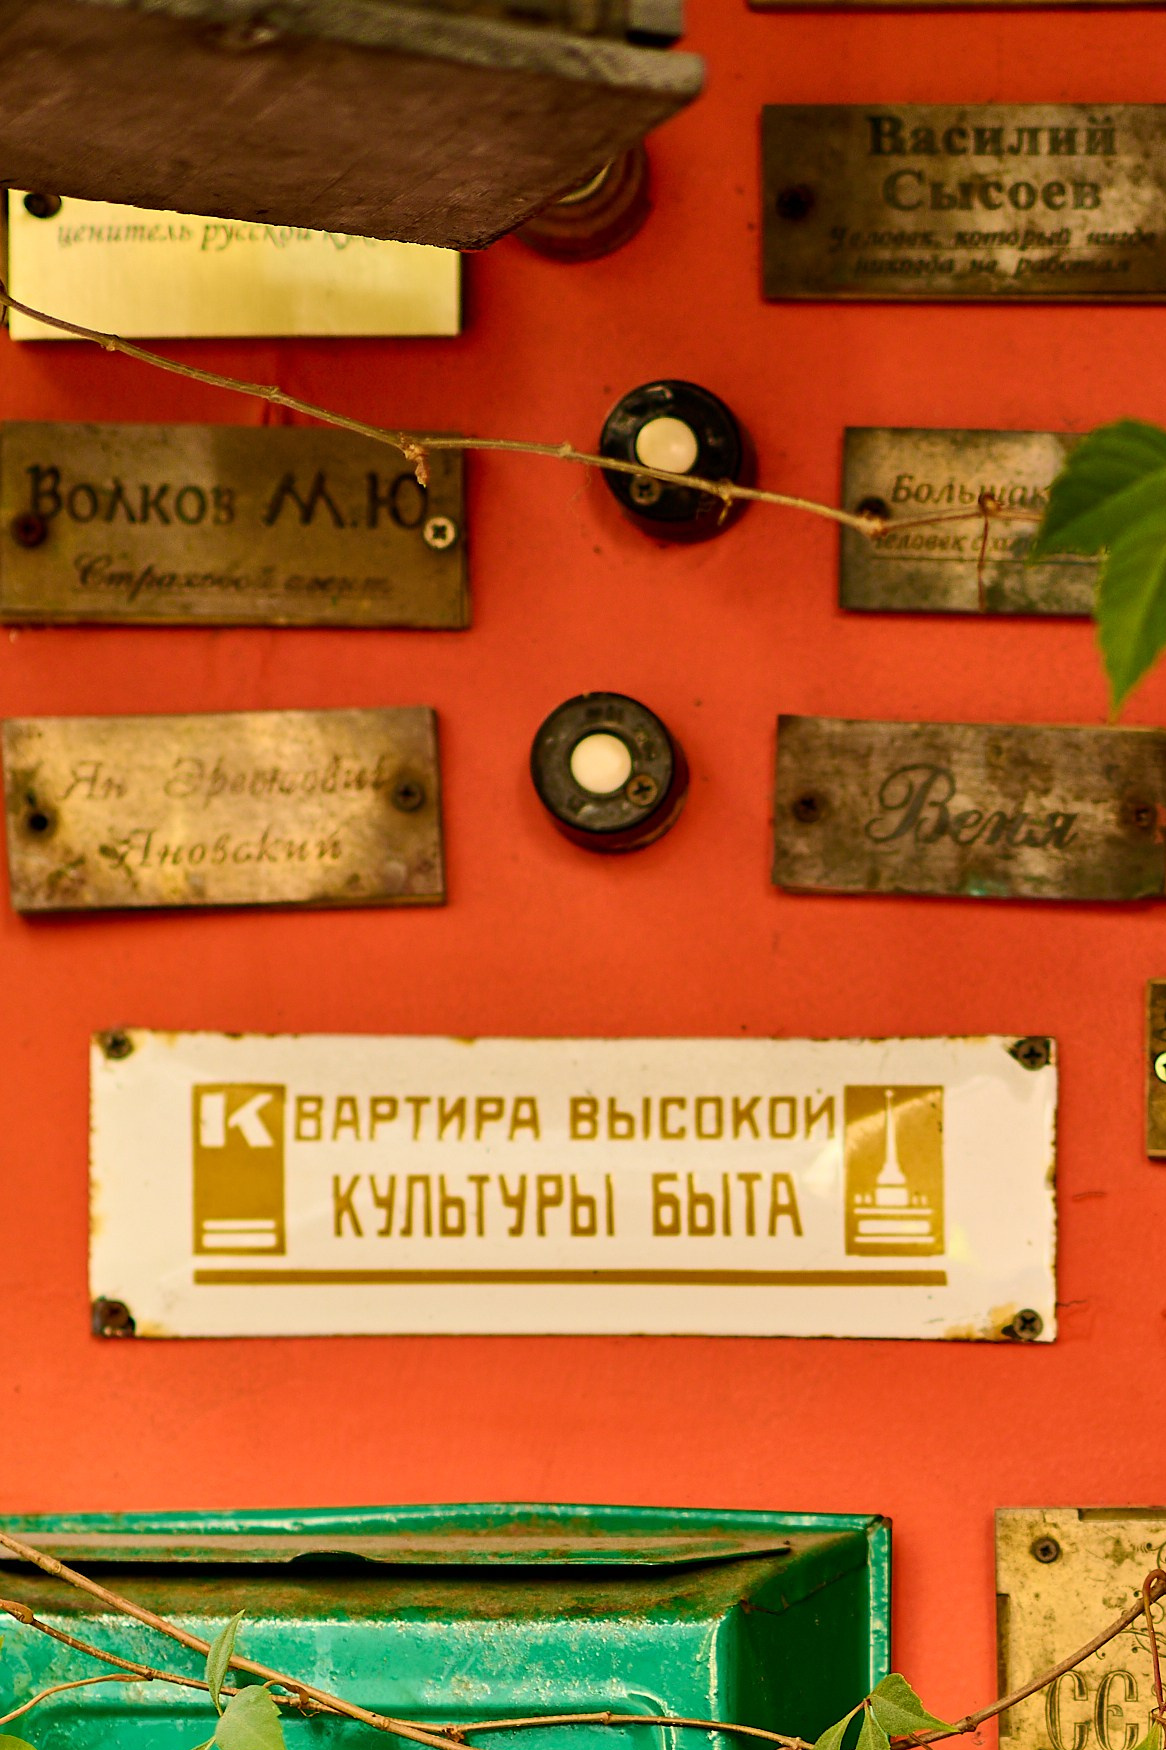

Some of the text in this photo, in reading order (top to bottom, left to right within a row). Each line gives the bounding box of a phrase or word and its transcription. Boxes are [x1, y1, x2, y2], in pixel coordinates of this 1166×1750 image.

[867, 114, 1117, 157] Василий
[881, 168, 1103, 212] Сысоев
[954, 226, 1073, 251] который
[26, 464, 237, 526] Волков
[63, 760, 128, 802] Ян
[108, 828, 342, 870] Яновский
[200, 1092, 541, 1149] КВАРТИРА
[332, 1172, 804, 1238] КУЛЬТУРЫ БЫТА
